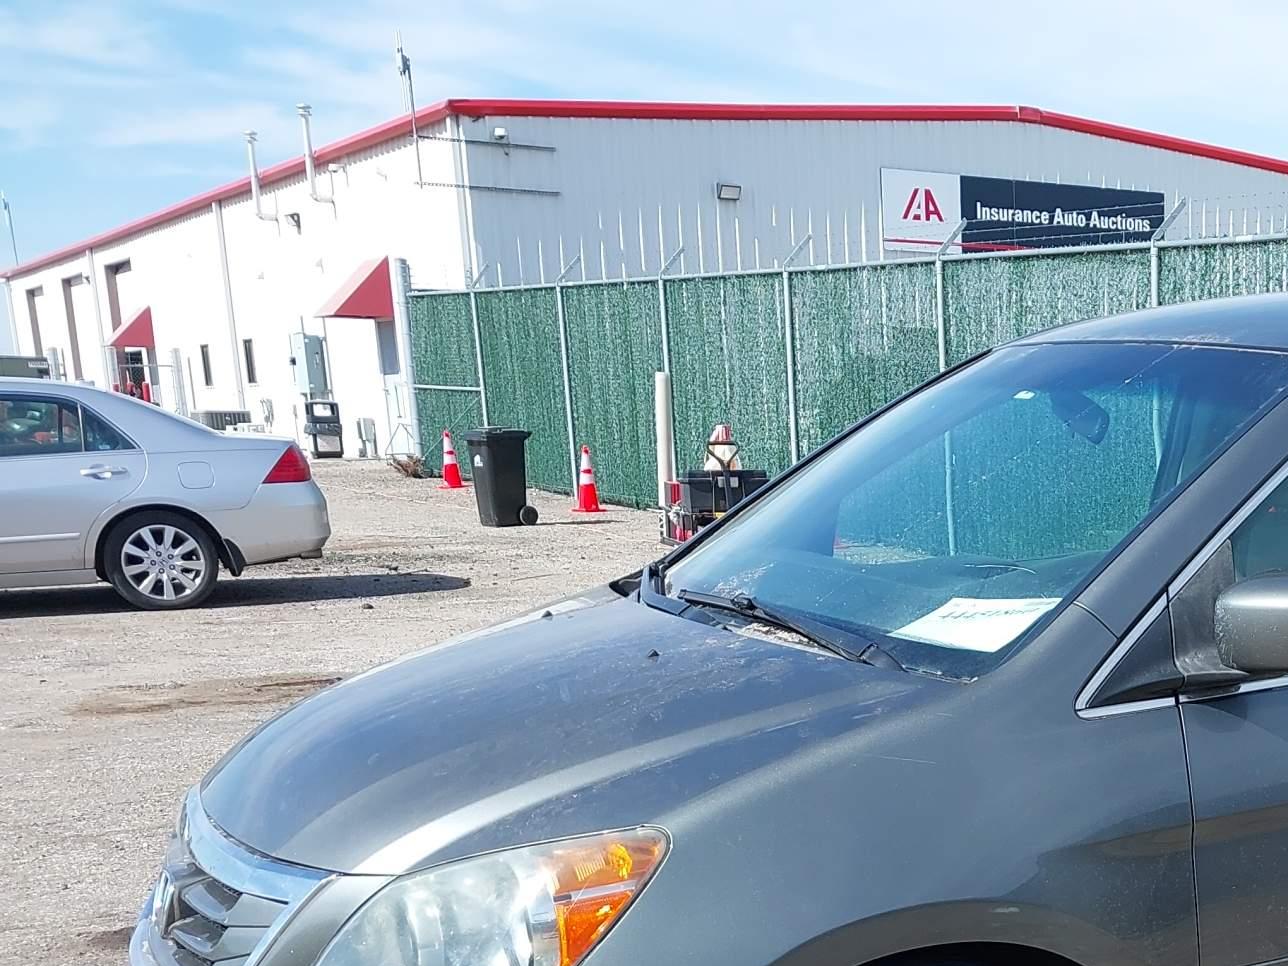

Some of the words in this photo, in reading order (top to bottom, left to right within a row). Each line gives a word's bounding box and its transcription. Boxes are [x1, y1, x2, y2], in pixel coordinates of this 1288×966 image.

[976, 201, 1050, 225] Insurance
[1053, 207, 1087, 228] Auto
[1089, 209, 1151, 232] Auctions
